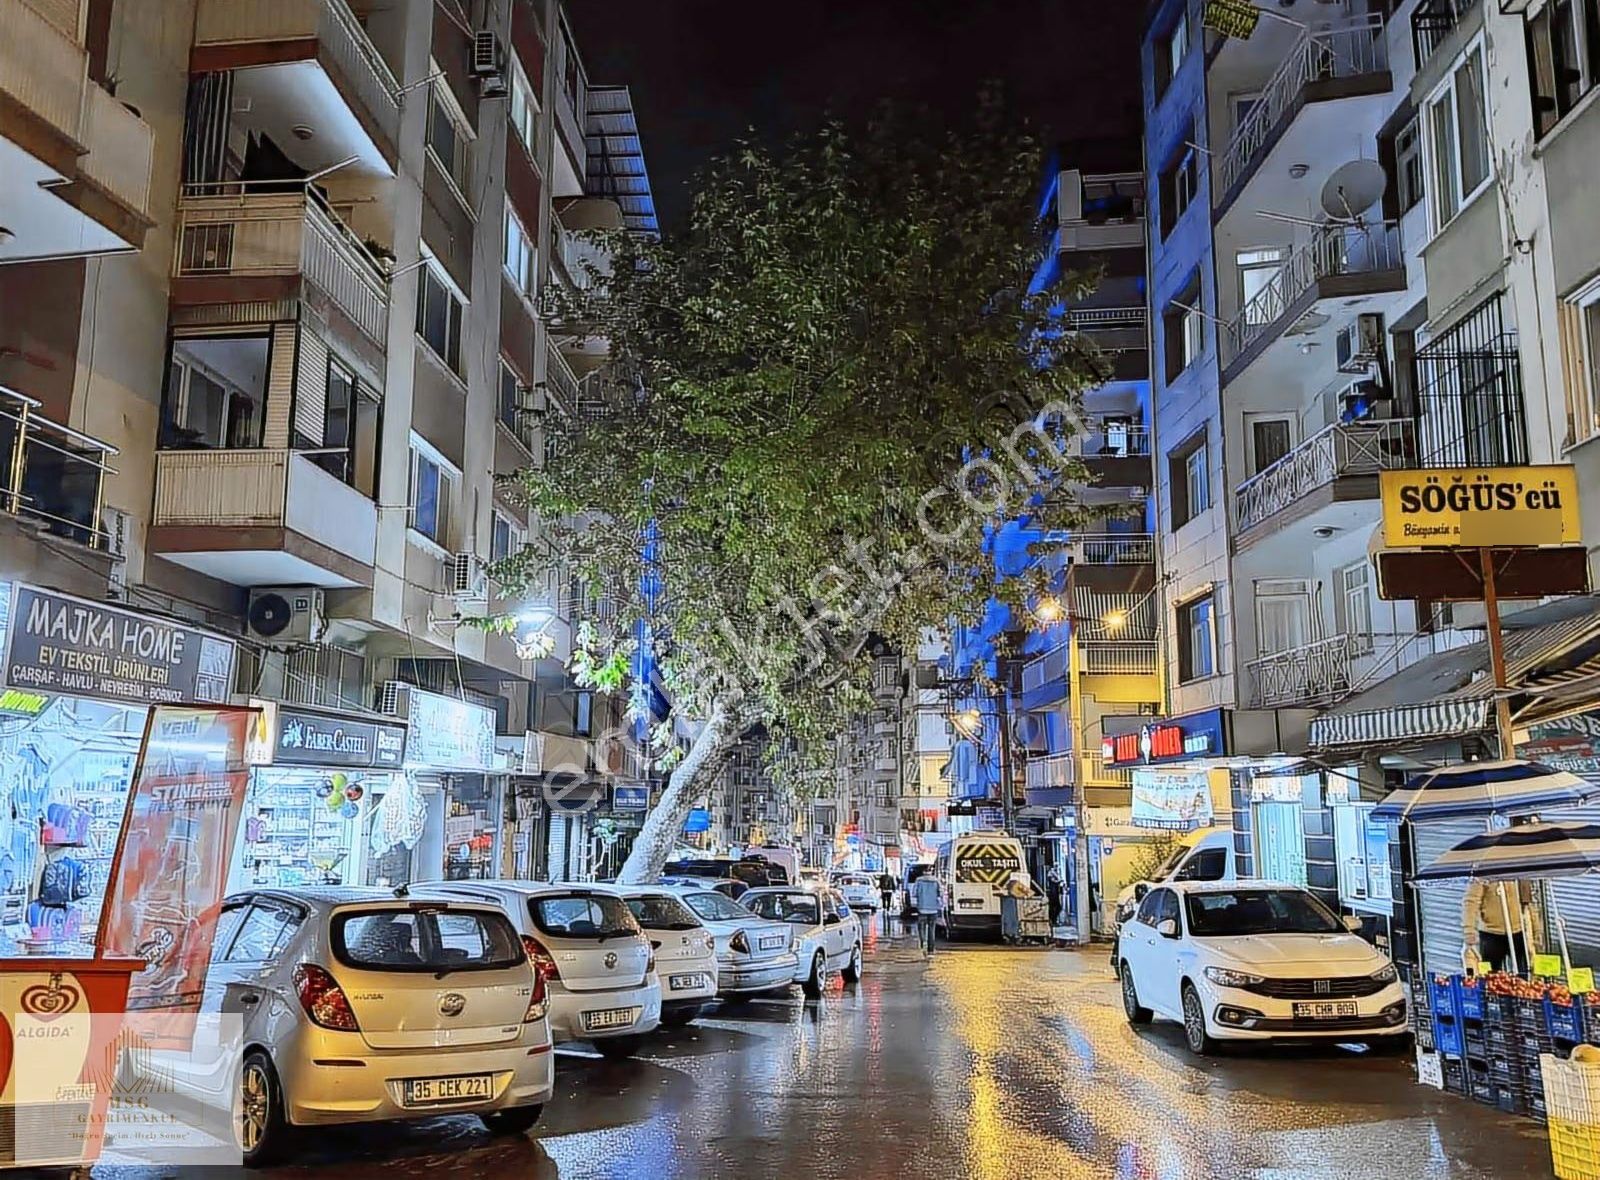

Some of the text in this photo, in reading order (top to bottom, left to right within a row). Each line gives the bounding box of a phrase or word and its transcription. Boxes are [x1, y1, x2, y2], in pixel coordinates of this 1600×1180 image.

[26, 597, 185, 664] MAJKA HOME
[39, 645, 169, 685] EV TEKSTİL ÜRÜNLERİ
[12, 665, 54, 687] ÇARŞAF
[62, 672, 94, 690] HAVLU
[961, 859, 984, 867] OKUL
[17, 1026, 70, 1038] ALGIDA
[415, 1078, 489, 1099] 35 CEK 221
